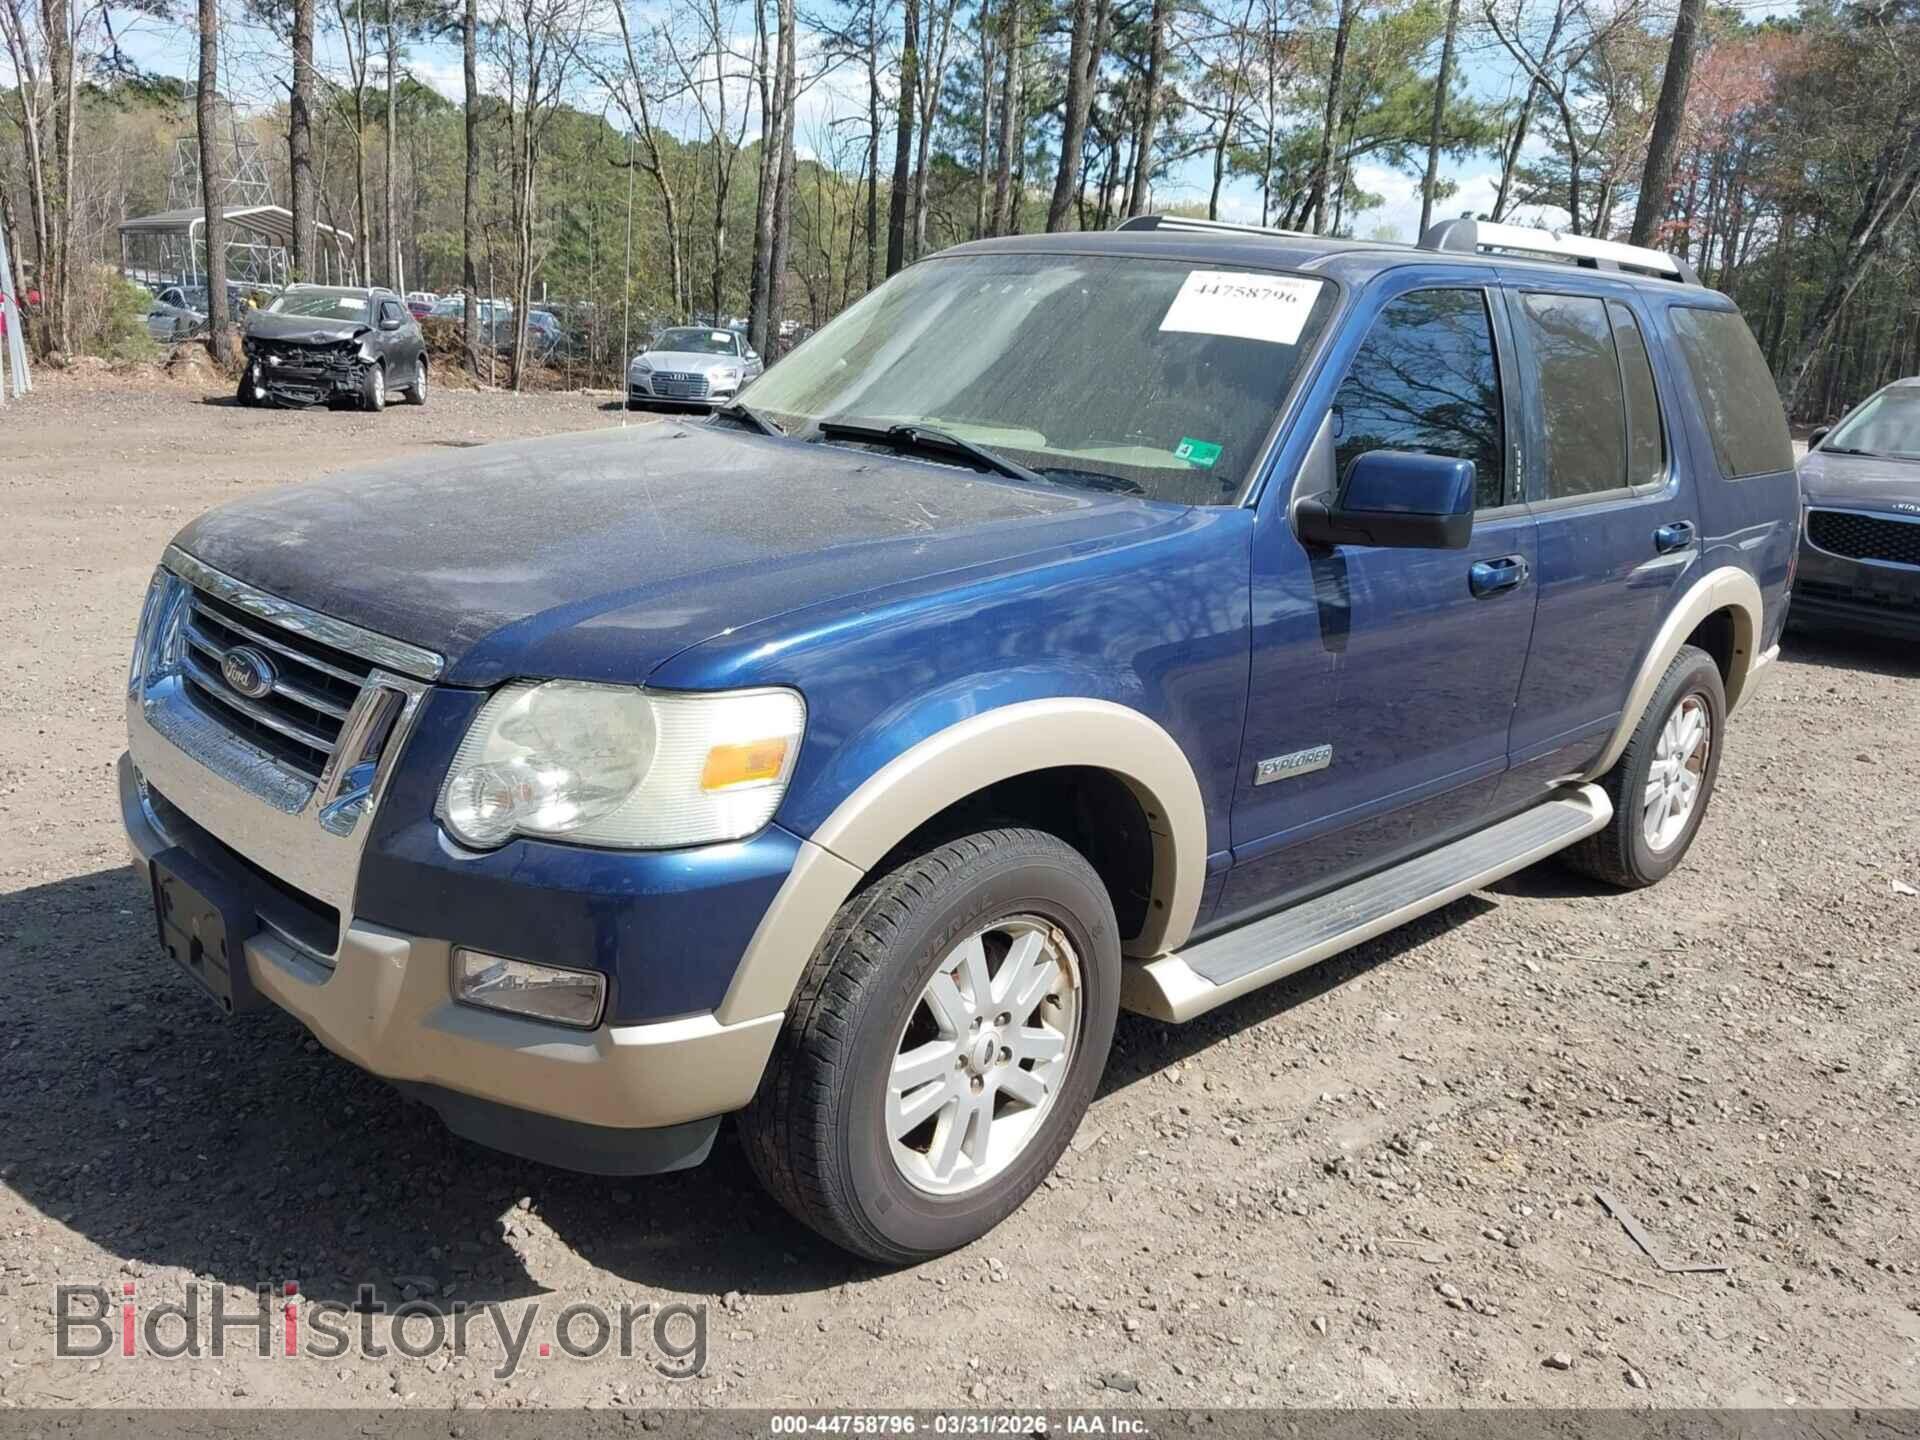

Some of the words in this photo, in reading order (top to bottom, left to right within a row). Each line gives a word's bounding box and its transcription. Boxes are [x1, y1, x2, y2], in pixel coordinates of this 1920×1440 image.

[1193, 283, 1298, 303] 44758796
[225, 655, 251, 687] Ford
[1262, 749, 1330, 775] EXPLORER
